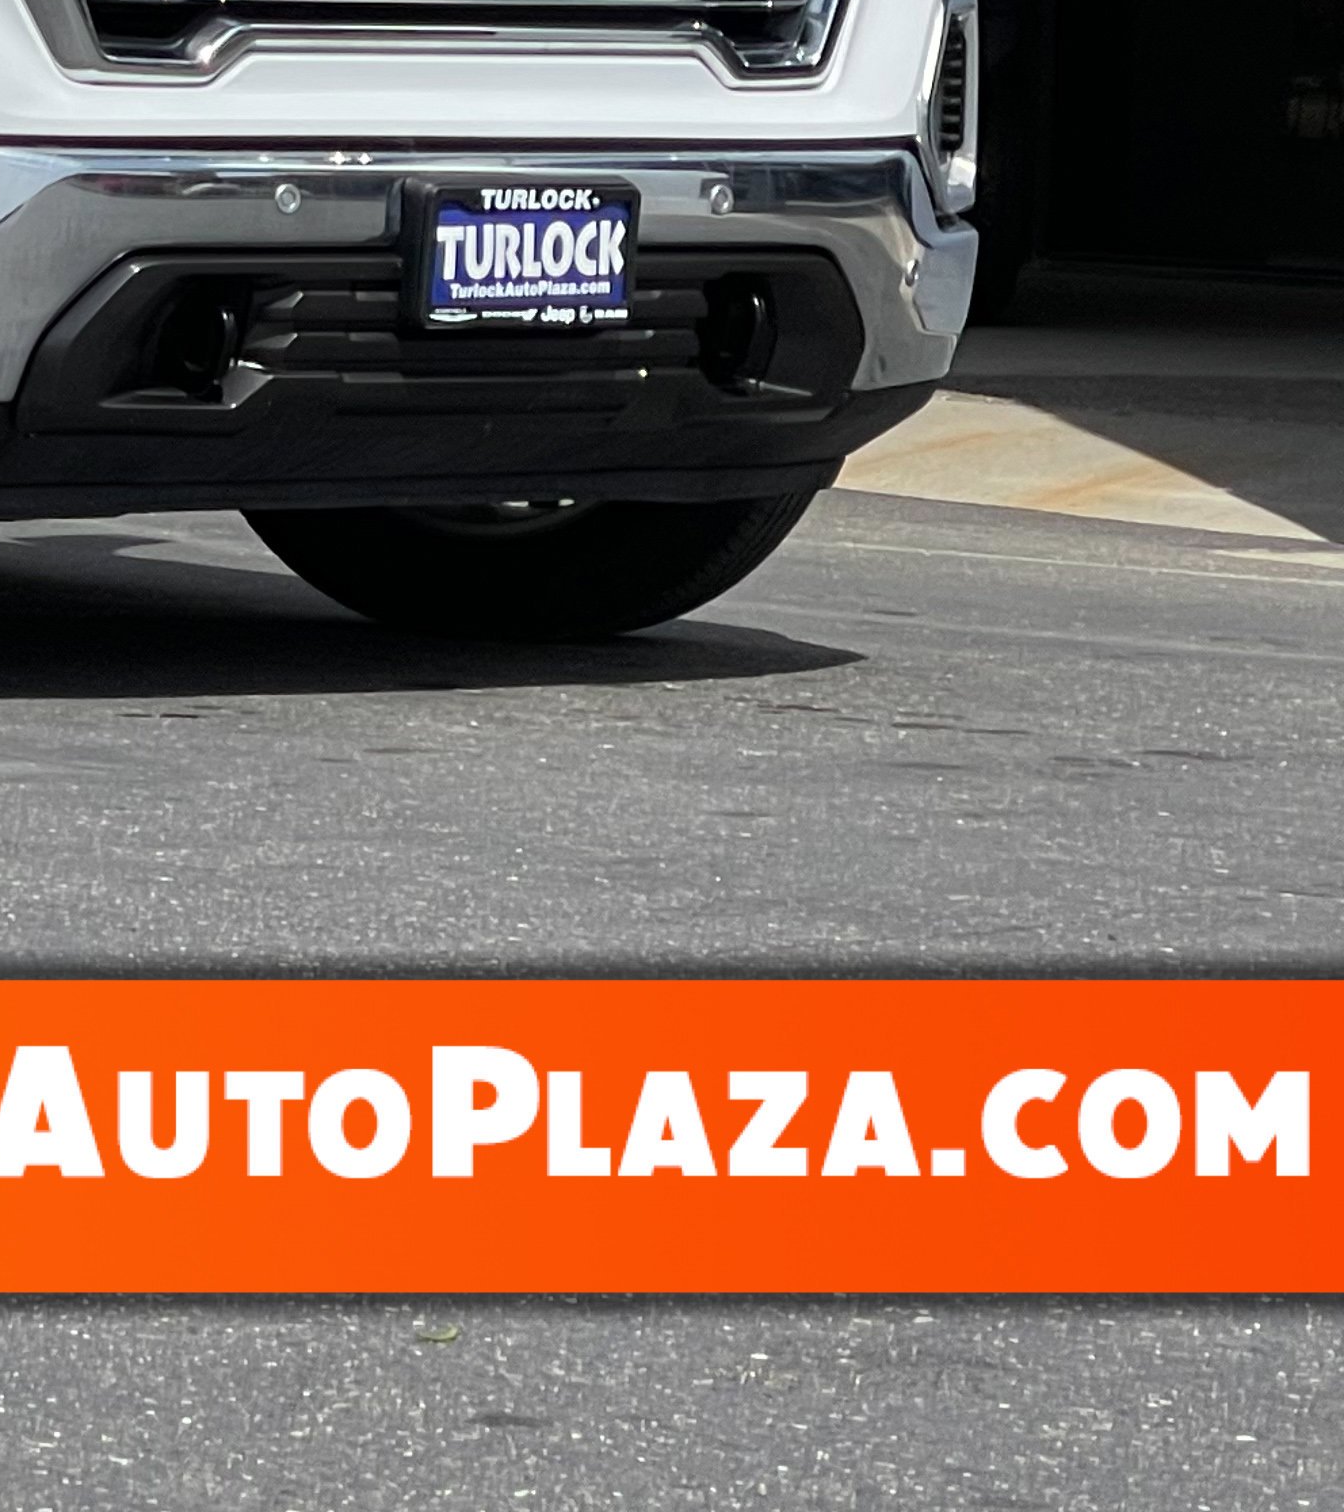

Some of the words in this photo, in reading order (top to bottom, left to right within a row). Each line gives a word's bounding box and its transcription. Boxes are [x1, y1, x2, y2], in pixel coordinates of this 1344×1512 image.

[480, 188, 593, 211] TURLOCK
[436, 219, 627, 281] TURLOCK
[449, 280, 611, 300] TurlockAutoPlaza.com
